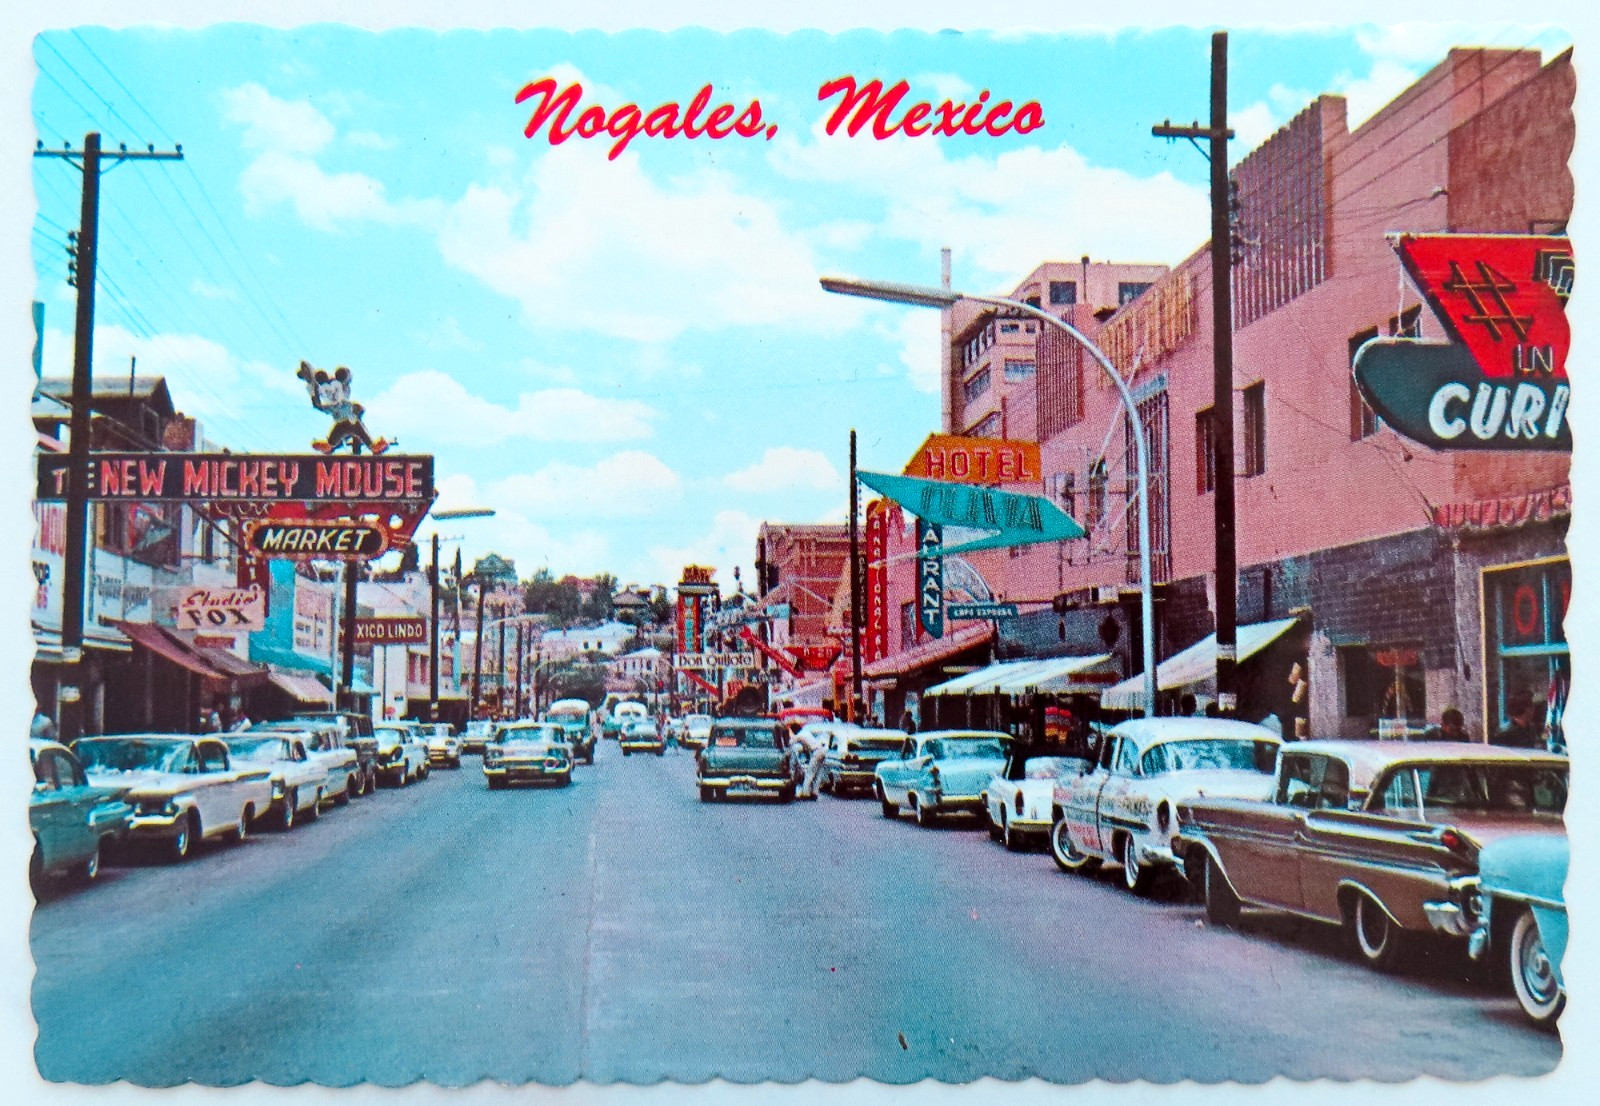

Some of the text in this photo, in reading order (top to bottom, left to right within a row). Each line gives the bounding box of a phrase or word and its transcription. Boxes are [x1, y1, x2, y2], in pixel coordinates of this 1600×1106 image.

[925, 447, 1033, 479] HOTEL
[100, 459, 168, 497] NEW
[182, 459, 300, 498] MICKEY
[312, 460, 424, 499] MOUSE
[262, 528, 372, 551] MARKET
[923, 523, 940, 625] AURANT
[187, 608, 252, 626] FOX
[387, 623, 423, 639] LINDO
[679, 654, 702, 667] Don
